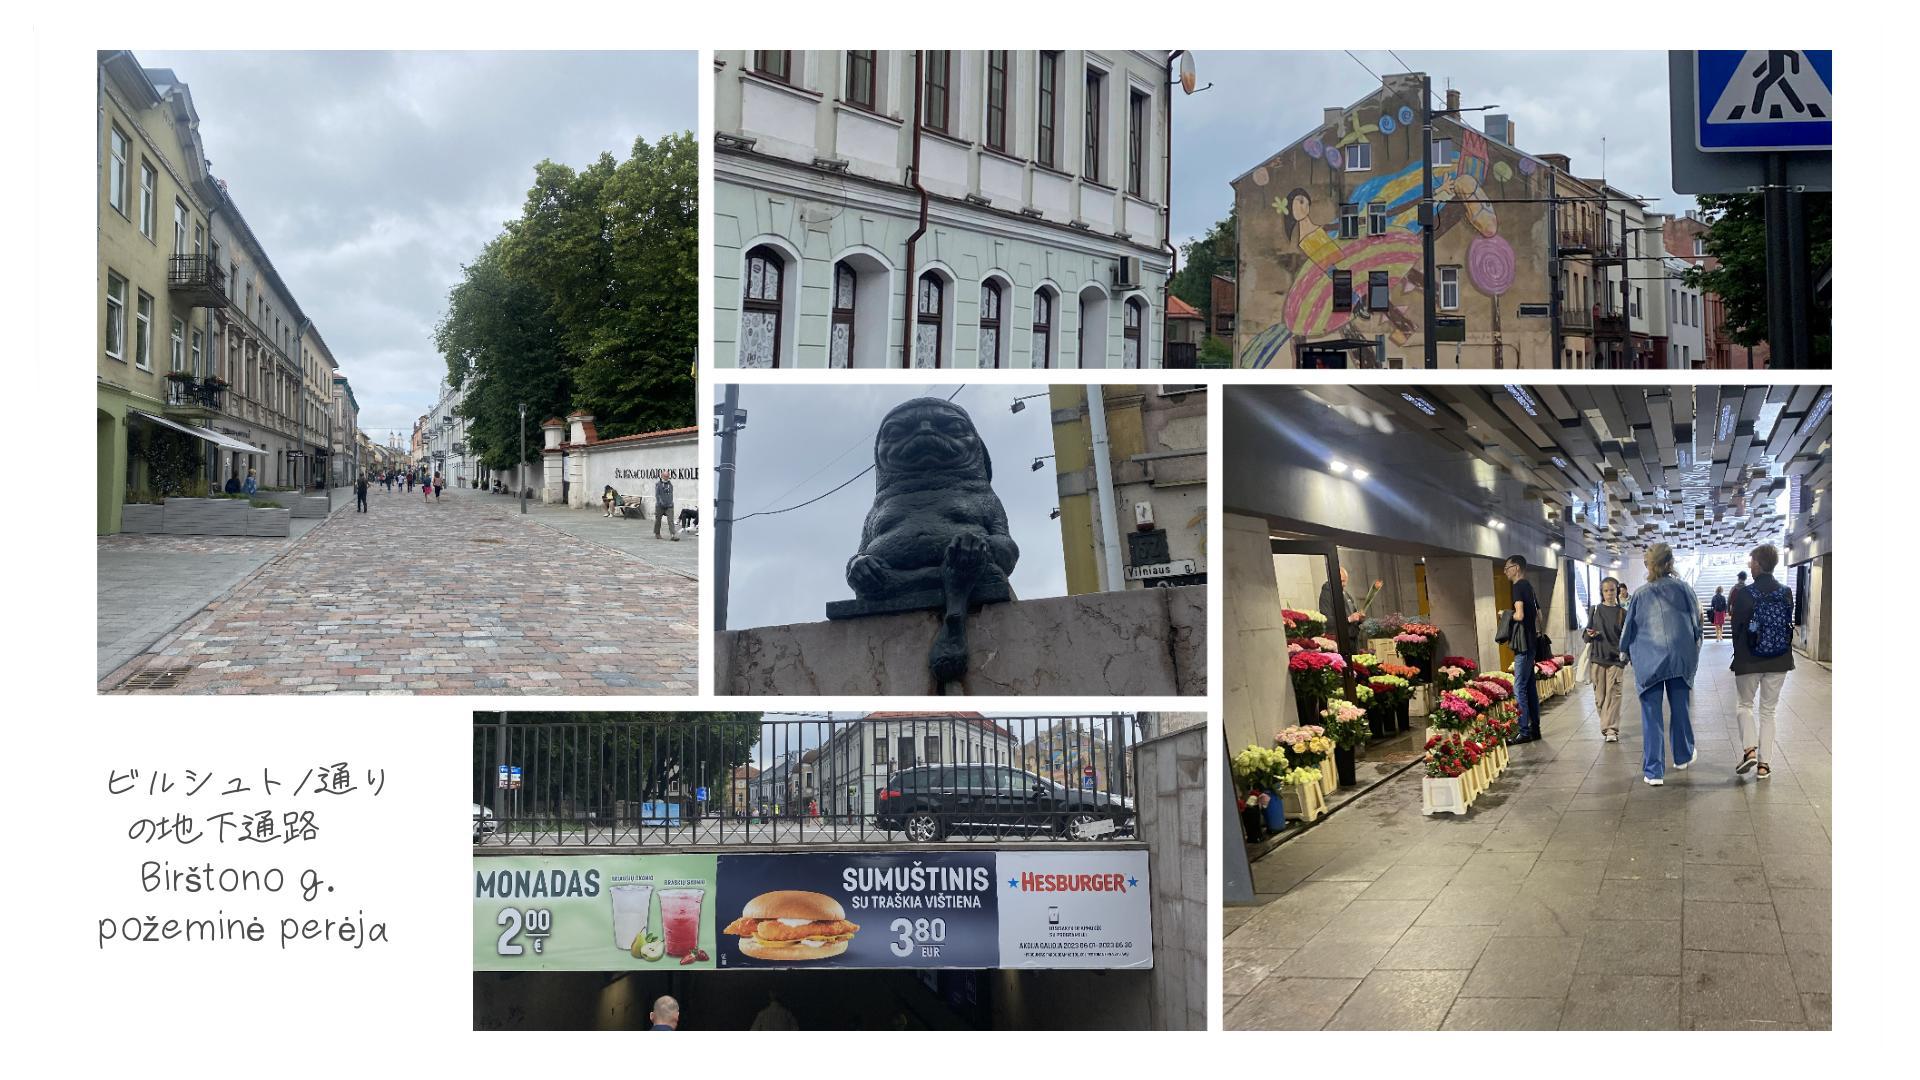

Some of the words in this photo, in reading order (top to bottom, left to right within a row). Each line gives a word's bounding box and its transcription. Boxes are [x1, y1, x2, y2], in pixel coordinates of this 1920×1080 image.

[646, 468, 677, 480] LOJOOS
[1128, 565, 1171, 578] Vilniaus
[1184, 564, 1193, 574] g.
[476, 869, 600, 899] MONADAS
[843, 861, 989, 892] SUMUŠTINIS
[1021, 872, 1126, 893] HESBURGER
[852, 896, 869, 909] SU
[872, 892, 922, 910] TRAŠKIA
[924, 892, 983, 910] VIŠTIENA
[921, 946, 940, 958] EUR
